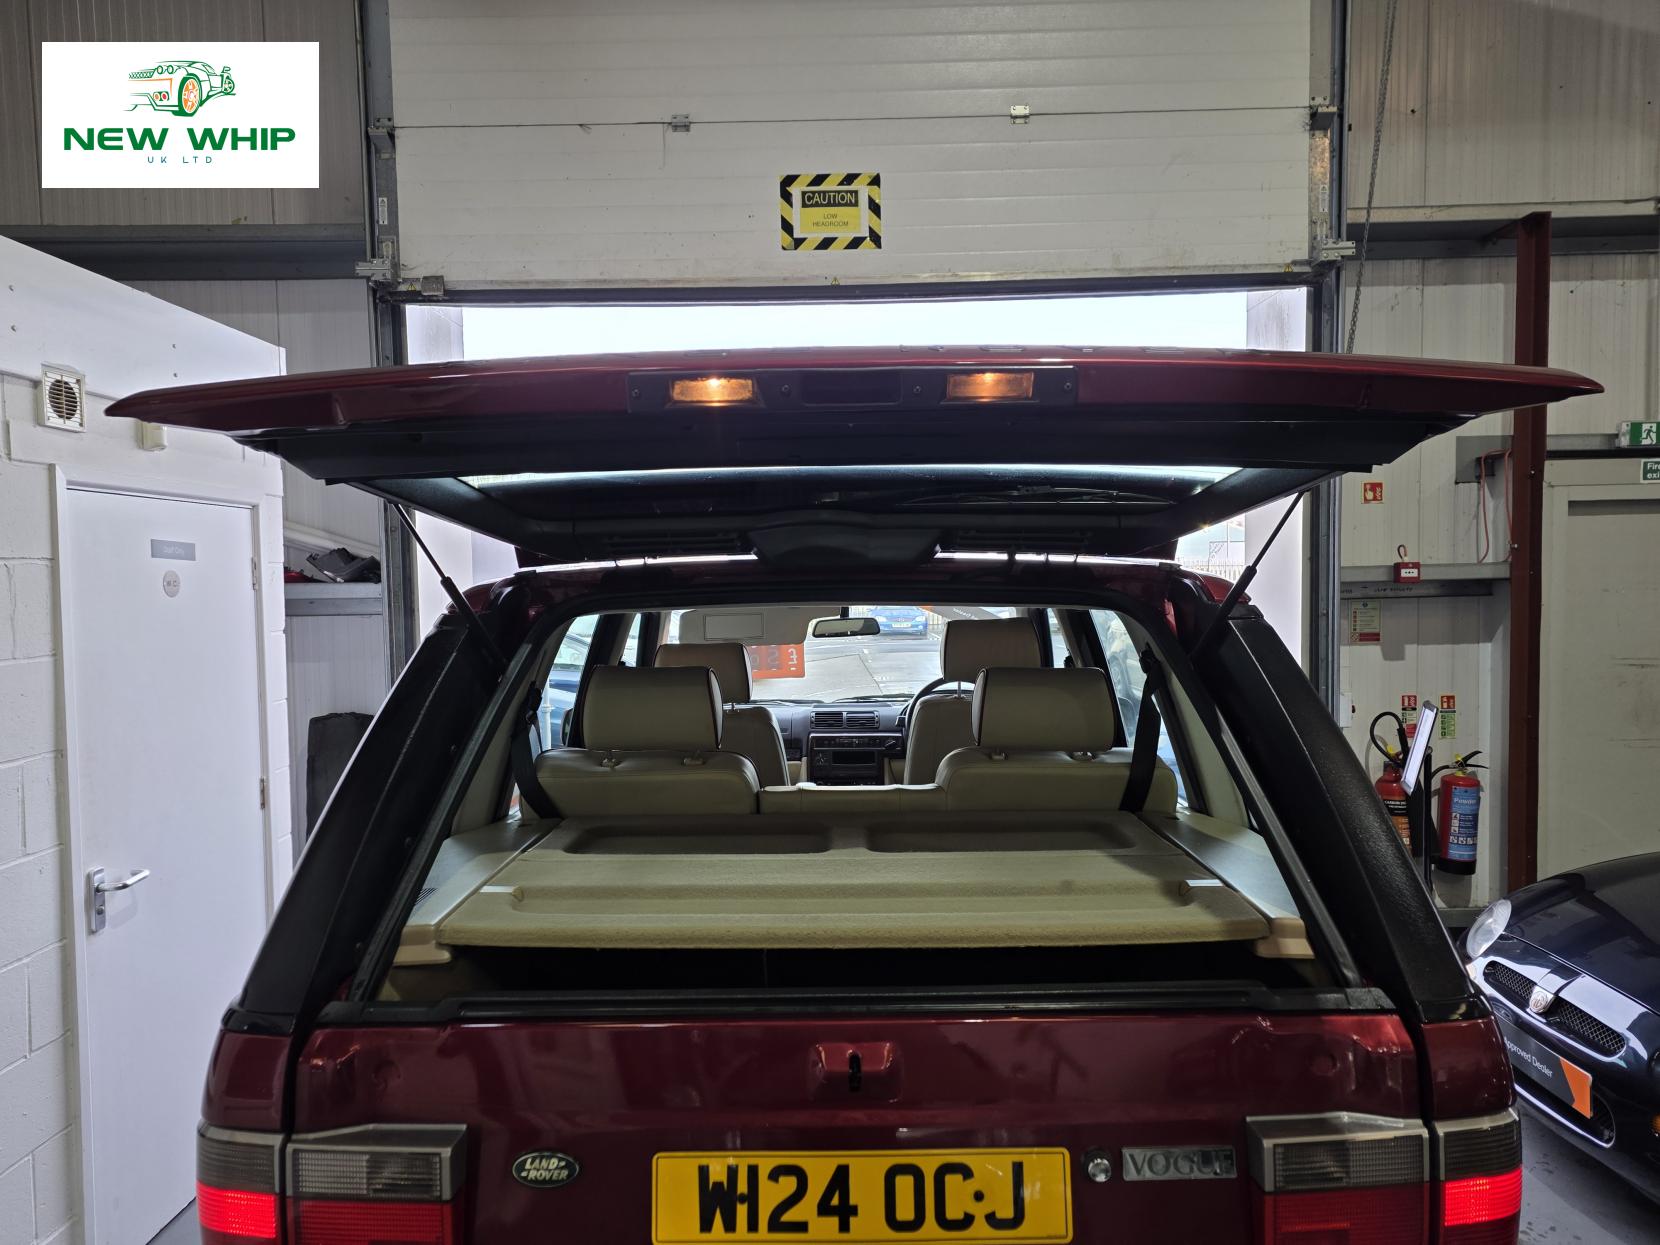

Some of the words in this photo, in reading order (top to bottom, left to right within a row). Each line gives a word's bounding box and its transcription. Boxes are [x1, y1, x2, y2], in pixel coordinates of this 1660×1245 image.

[804, 192, 855, 205] CAUTION
[812, 220, 849, 228] HEADROOM
[1647, 471, 1660, 479] exi
[1531, 1055, 1553, 1078] Dealer
[524, 1157, 559, 1170] LAND
[1127, 1150, 1233, 1177] VOGUE
[527, 1169, 569, 1181] ROVER
[884, 1161, 1026, 1233] OCJ
